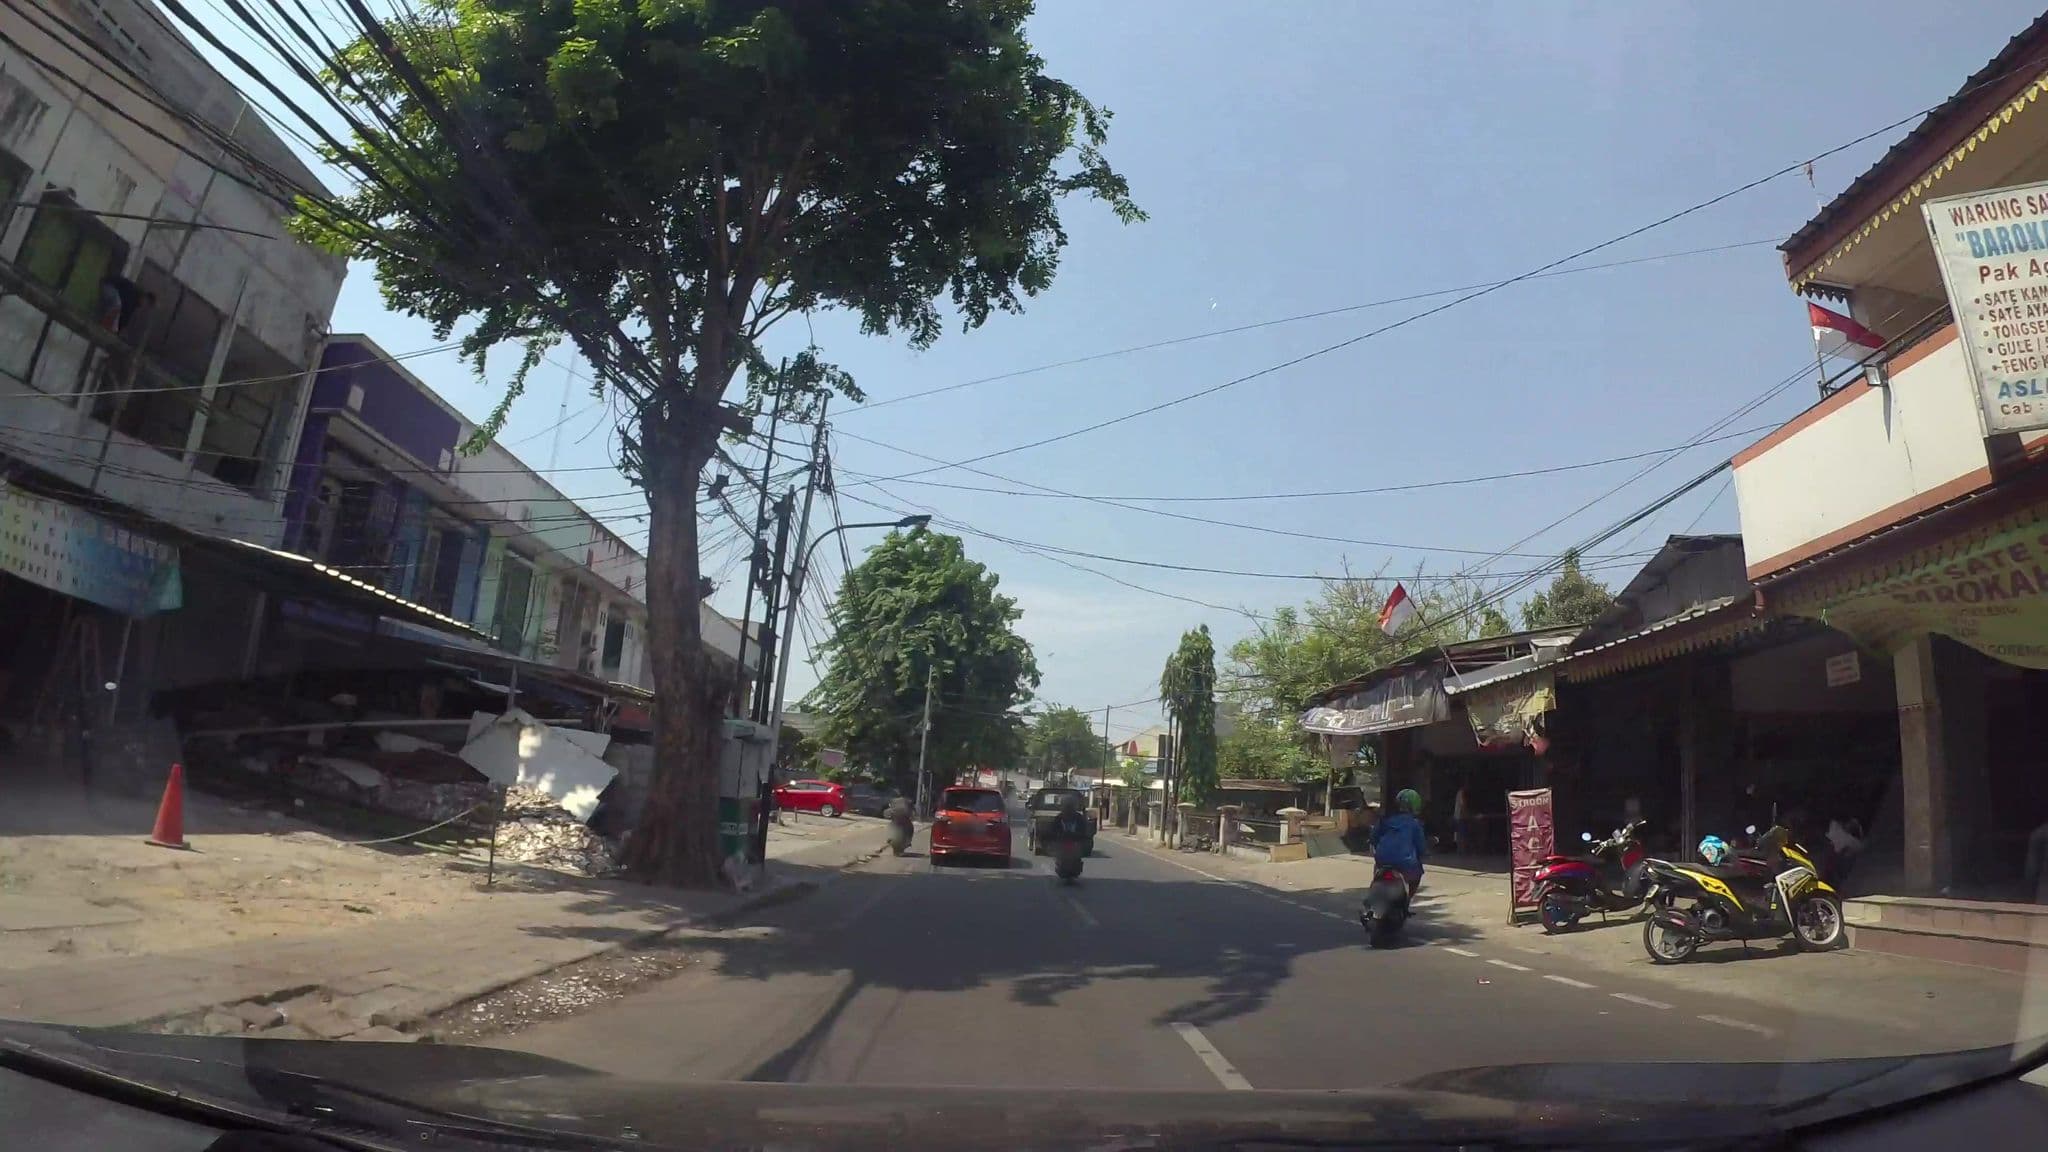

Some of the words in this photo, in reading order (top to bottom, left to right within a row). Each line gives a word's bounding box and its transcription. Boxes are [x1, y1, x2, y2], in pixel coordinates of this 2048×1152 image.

[1948, 198, 2022, 226] WARUNG
[2027, 191, 2048, 215] SA
[1979, 262, 2019, 284] Pak
[1985, 289, 2018, 306] SATE
[1989, 305, 2022, 322] SATE
[1993, 320, 2048, 339] TONGSE
[1998, 339, 2033, 356] GULE
[2000, 402, 2032, 415] Cab
